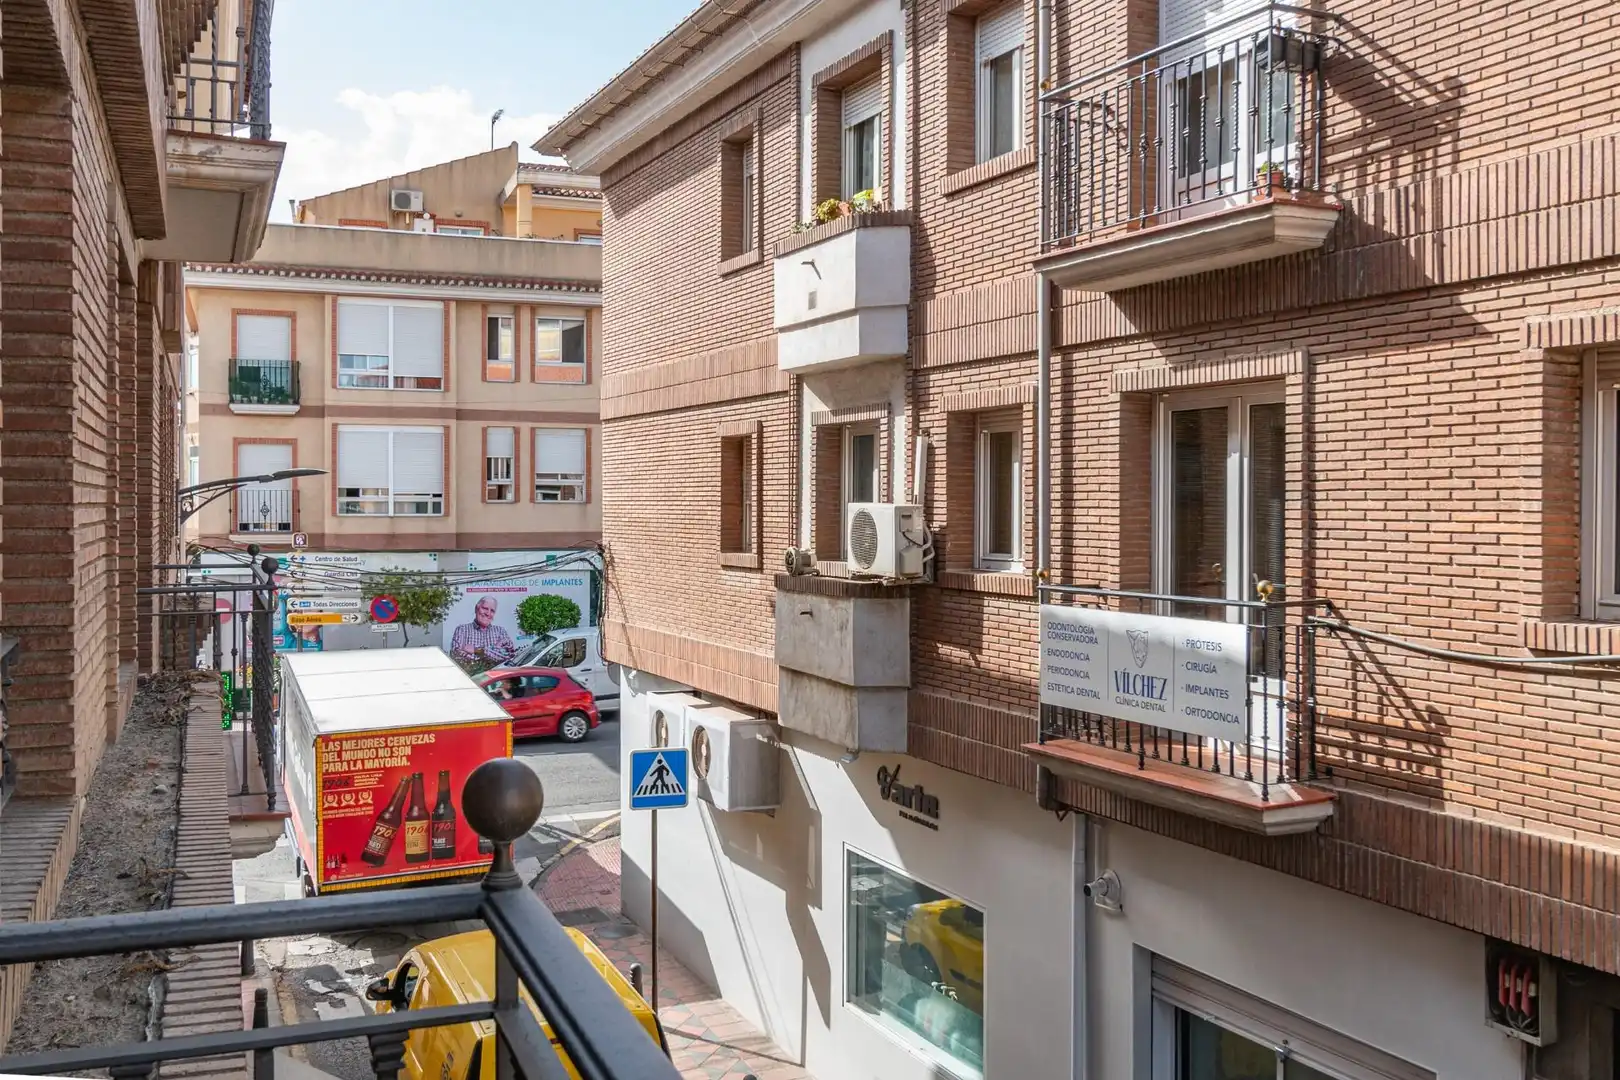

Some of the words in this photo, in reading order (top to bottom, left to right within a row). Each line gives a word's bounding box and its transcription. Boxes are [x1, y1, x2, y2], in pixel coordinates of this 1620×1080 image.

[541, 578, 583, 586] IMPLANTES
[1047, 631, 1099, 644] CONSERVADORA
[1047, 648, 1091, 662] ENDODONCIA
[1047, 665, 1091, 679] PERIODONCIA
[1185, 661, 1217, 674] CIRUGÍA
[1114, 667, 1168, 701] VÍLCHEZ
[1076, 687, 1101, 700] DENTAL
[1185, 684, 1230, 700] IMPLANTES
[1140, 701, 1166, 713] DENTAL
[1185, 706, 1240, 724] ORTODONCIA
[322, 742, 341, 753] LAS
[342, 737, 386, 751] MEJORES
[387, 733, 436, 748] CERVEZAS
[322, 752, 341, 763] DEL
[341, 748, 377, 761] MUNDO
[378, 747, 391, 758] NO
[392, 745, 412, 757] SON
[322, 762, 349, 773] PARA
[349, 760, 363, 771] LA
[364, 756, 411, 770] MAYORÍA.
